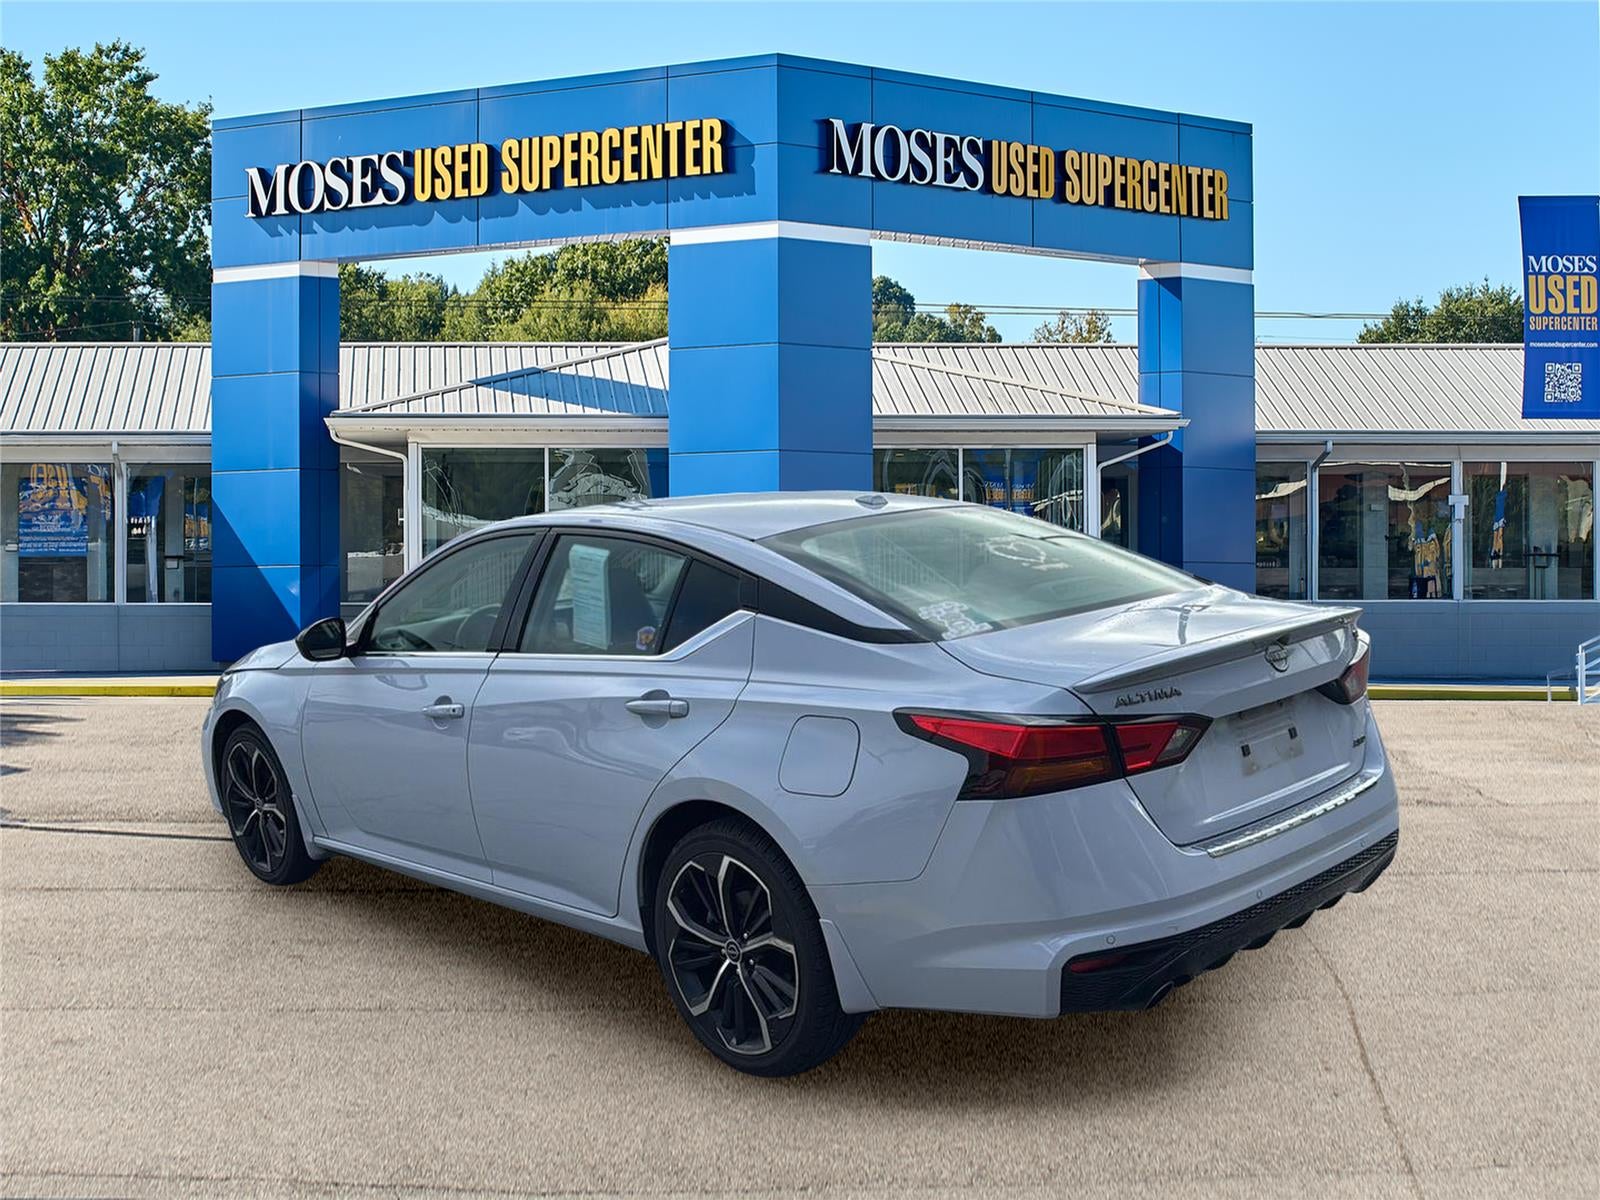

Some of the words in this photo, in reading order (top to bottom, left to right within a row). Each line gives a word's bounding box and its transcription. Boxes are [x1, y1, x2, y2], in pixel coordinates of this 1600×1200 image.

[244, 150, 407, 218] MOSES
[413, 143, 489, 202] USED
[501, 118, 724, 194] SUPERCENTER
[828, 118, 985, 191] MOSES
[991, 139, 1055, 199] USED
[1065, 149, 1230, 221] SUPERCENTER
[1527, 255, 1598, 274] MOSES
[1528, 275, 1599, 315] USED
[1529, 316, 1599, 331] SUPERCENTER
[1114, 686, 1183, 709] ALTIMA
